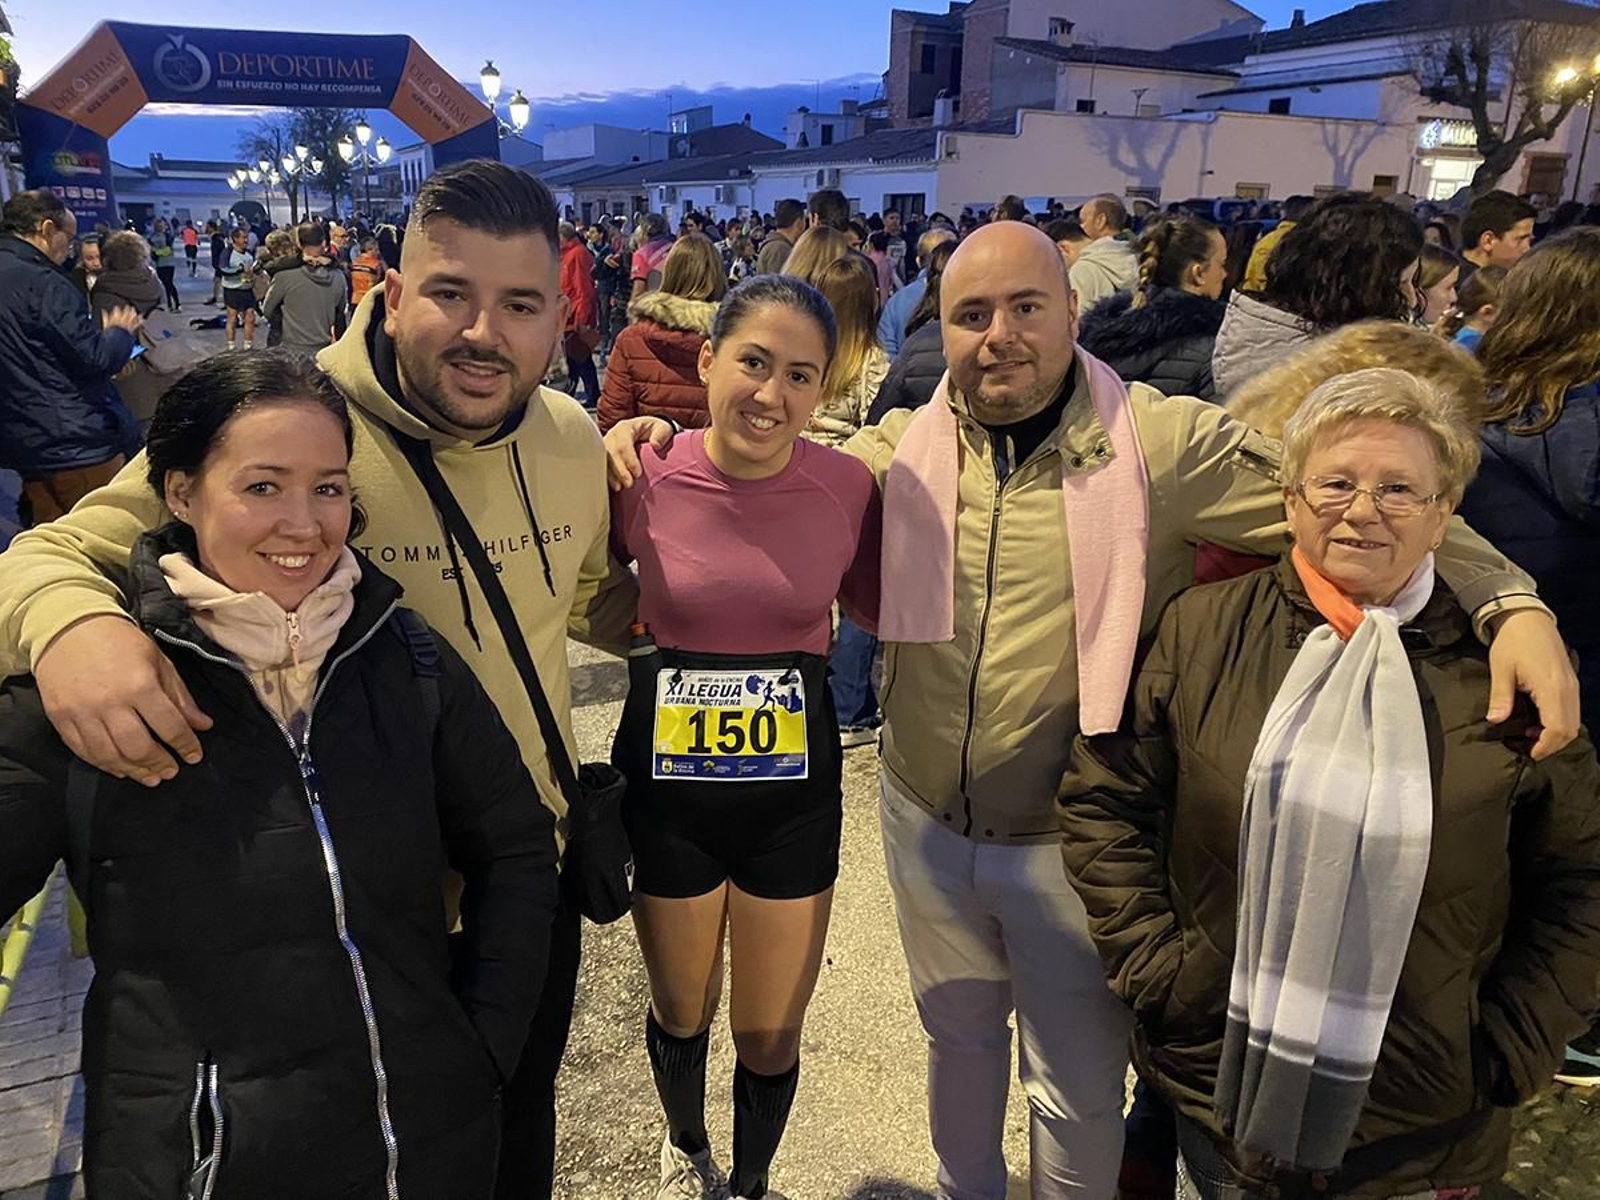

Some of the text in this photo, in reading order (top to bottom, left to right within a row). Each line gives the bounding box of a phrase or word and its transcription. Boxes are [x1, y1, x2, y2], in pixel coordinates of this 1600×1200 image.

[216, 50, 375, 80] DEPORTIME
[216, 80, 382, 94] SIN ESFUERZO NO HAY RECOMPENSA
[665, 682, 742, 698] XI LEGUA
[664, 697, 741, 706] URBANA NOCTURNA
[687, 709, 778, 754] 150
